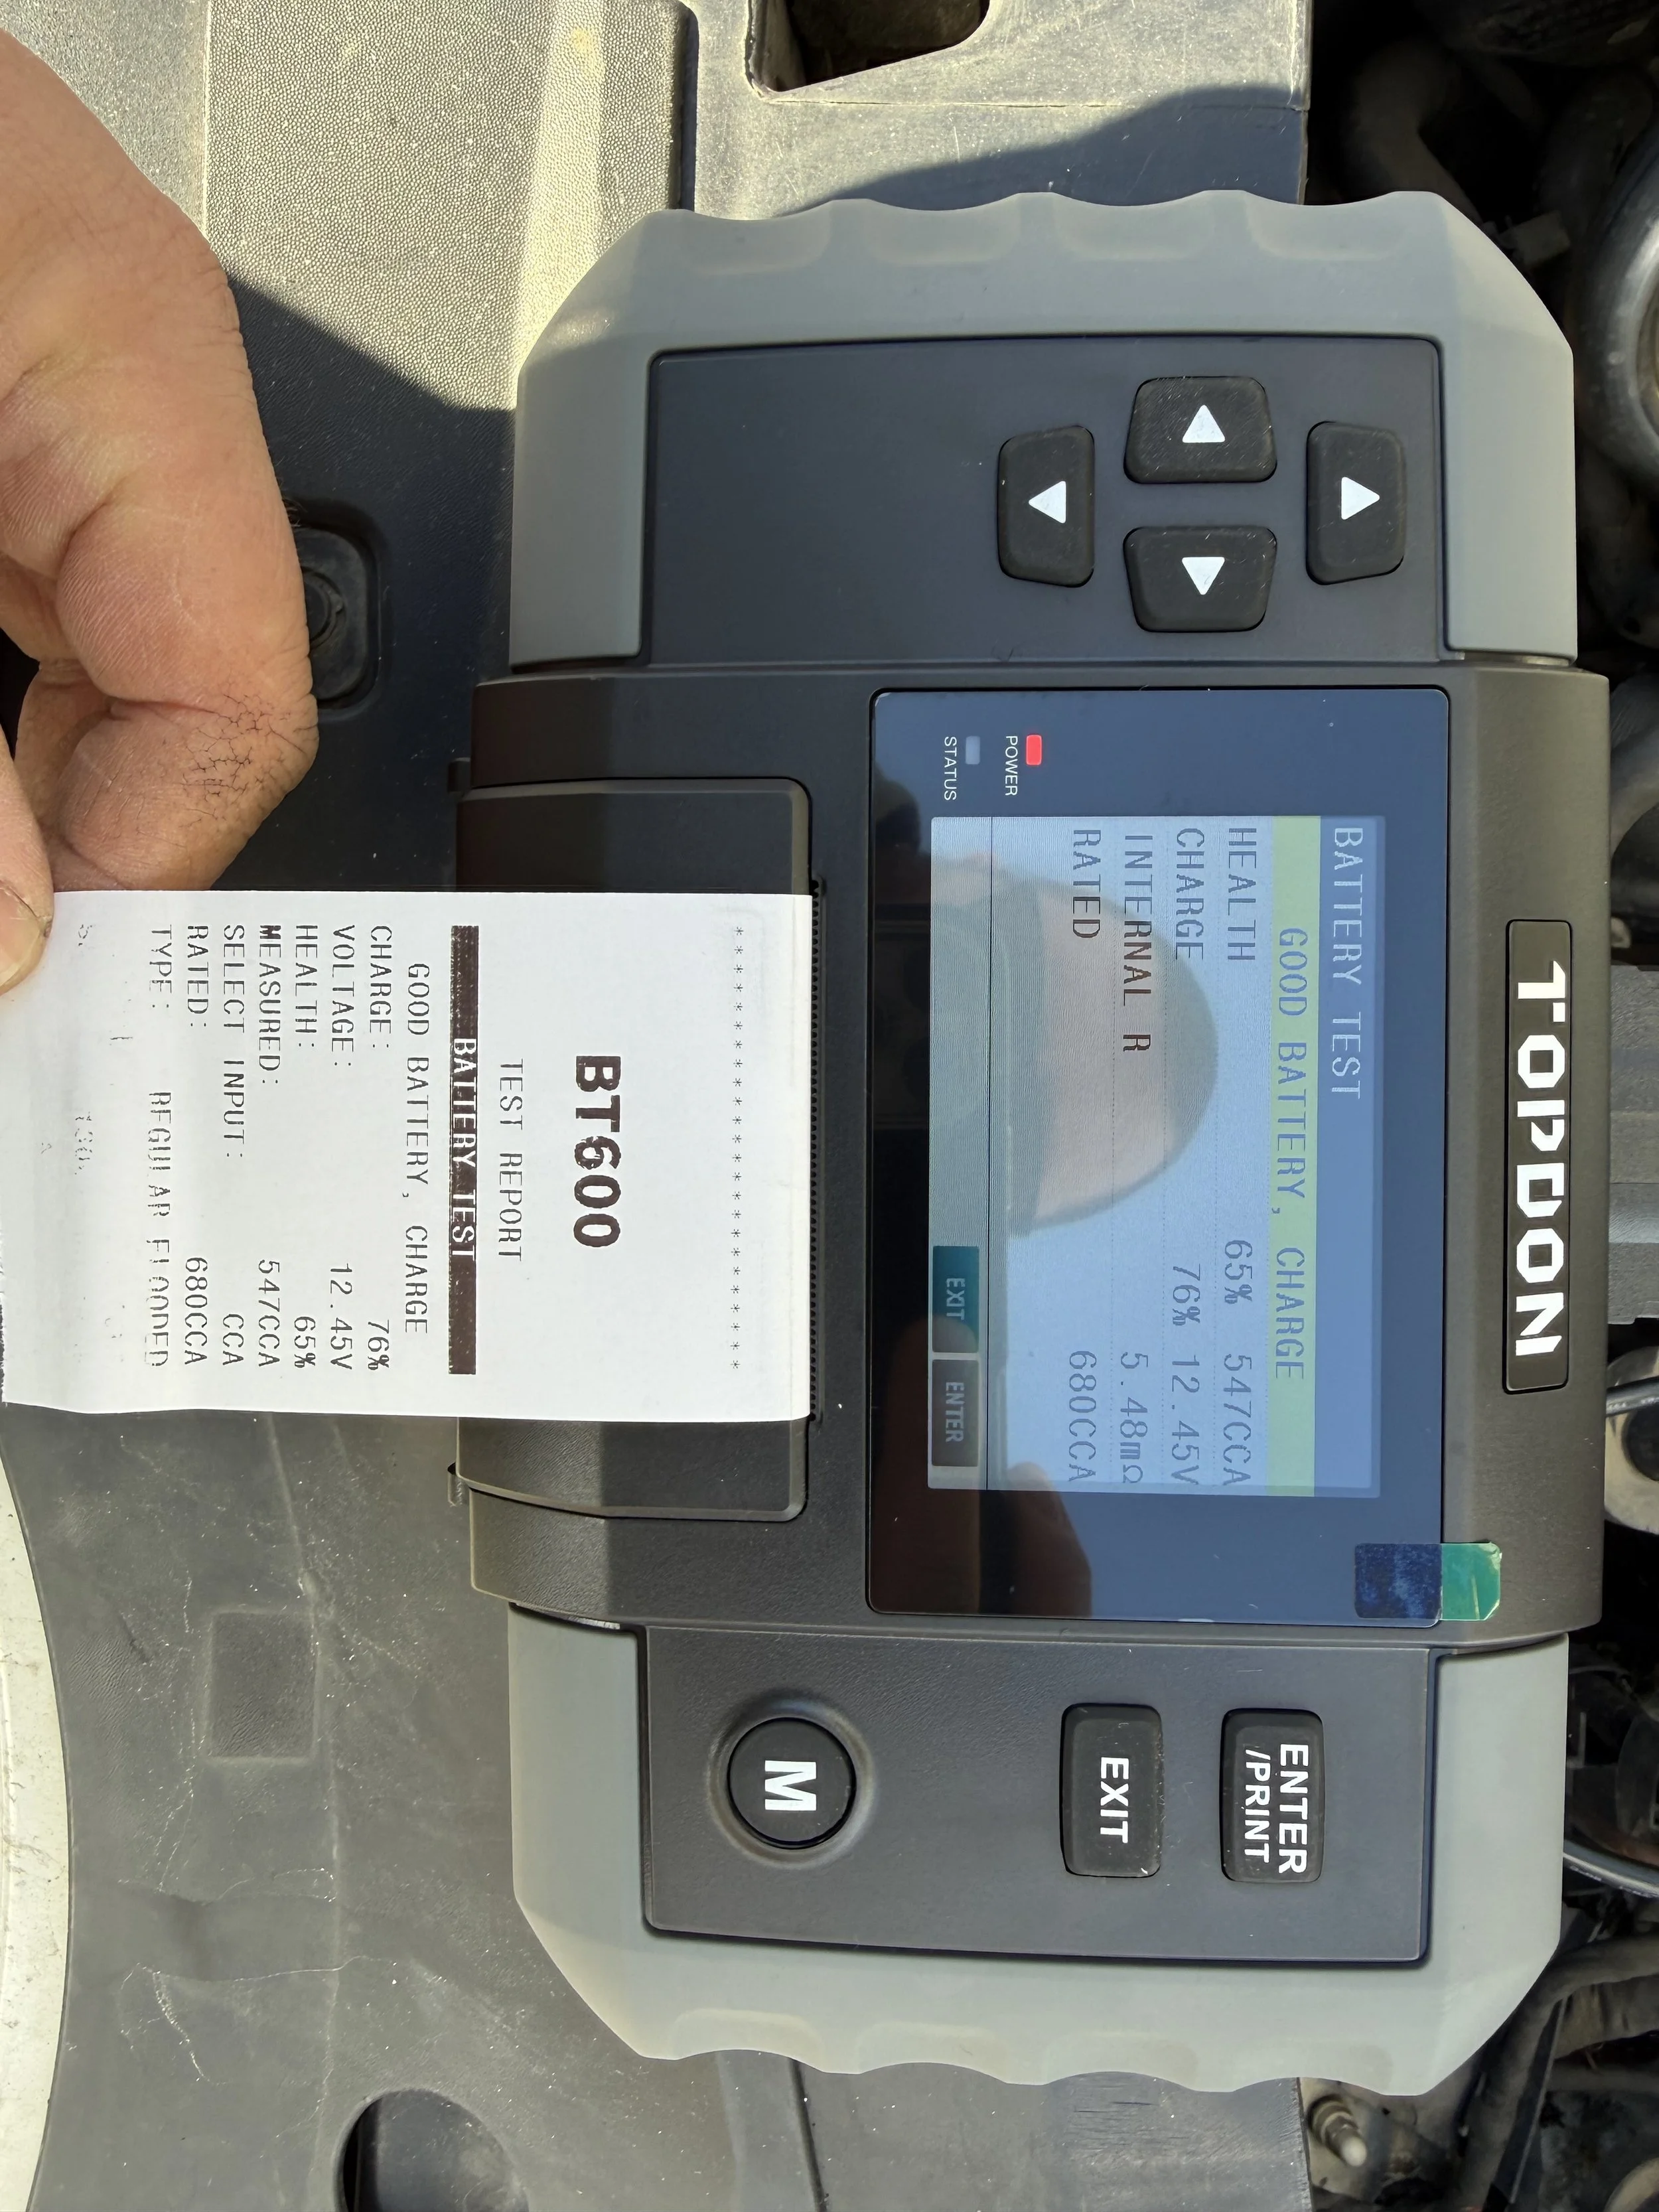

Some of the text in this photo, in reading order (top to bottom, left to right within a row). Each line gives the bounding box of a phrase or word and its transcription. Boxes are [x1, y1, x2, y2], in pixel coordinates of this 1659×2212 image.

[944, 737, 957, 800] STATUS
[1005, 736, 1018, 795] POWER
[149, 924, 173, 1008] TYPE:
[408, 964, 429, 1035] GOOD
[1123, 836, 1152, 1051] INTERNAL R
[1279, 928, 1307, 1015] GOOD
[1332, 828, 1362, 1099] BATTERY TEST
[184, 926, 208, 1364] RATED: 680CCA
[223, 925, 244, 1365] SELECT INPUT: CCA
[259, 925, 281, 1366] MEASURED: 547CCA
[295, 926, 317, 1368] HEALTH: 65%
[330, 925, 354, 1369] VOLTAGE: 12.45V
[368, 926, 392, 1370] CHARGE: 76%
[451, 1038, 476, 1262] BATTERY TEST
[499, 1059, 523, 1261] TEST REPORT
[573, 1056, 621, 1247] BT600
[1068, 830, 1100, 1481] RATED 680CCA
[1171, 828, 1204, 1485] CHARGE 76% 12.45V
[1223, 828, 1256, 1486] HEALTH 65% 547CCA
[1516, 961, 1565, 1355] TOPDON
[405, 1226, 427, 1333] CHARGE
[946, 1278, 965, 1320] EXIT
[1276, 1248, 1305, 1378] CHARGE
[946, 1382, 964, 1441] ENTER
[765, 1761, 816, 1810] M
[1100, 1757, 1129, 1843] EXIT
[1244, 1749, 1271, 1863] /PRINT
[1279, 1744, 1308, 1873] ENTER
